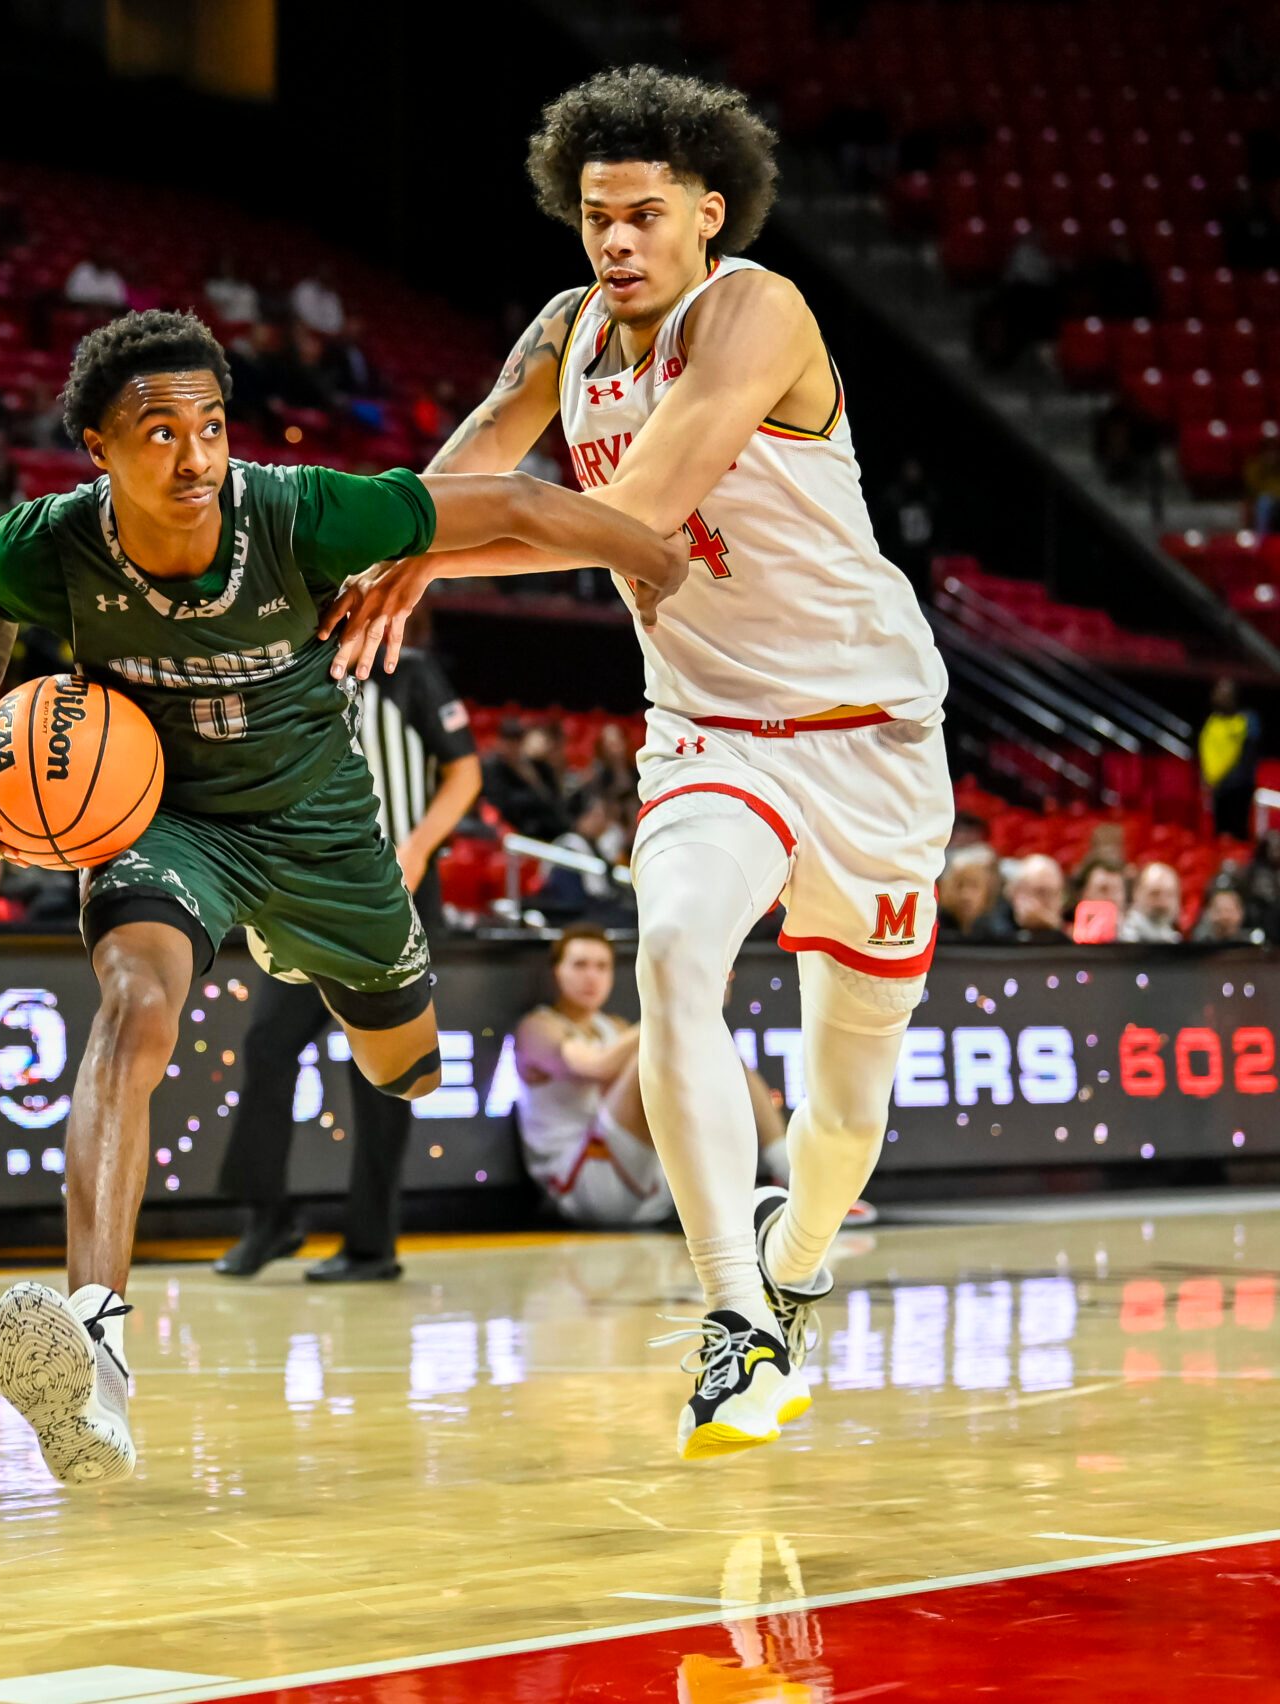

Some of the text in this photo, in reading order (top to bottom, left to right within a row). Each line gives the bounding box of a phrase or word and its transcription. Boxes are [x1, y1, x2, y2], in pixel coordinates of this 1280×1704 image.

[108, 639, 298, 688] WAGNER
[191, 692, 248, 743] 0
[869, 891, 919, 940] M
[1119, 1026, 1278, 1098] 602
